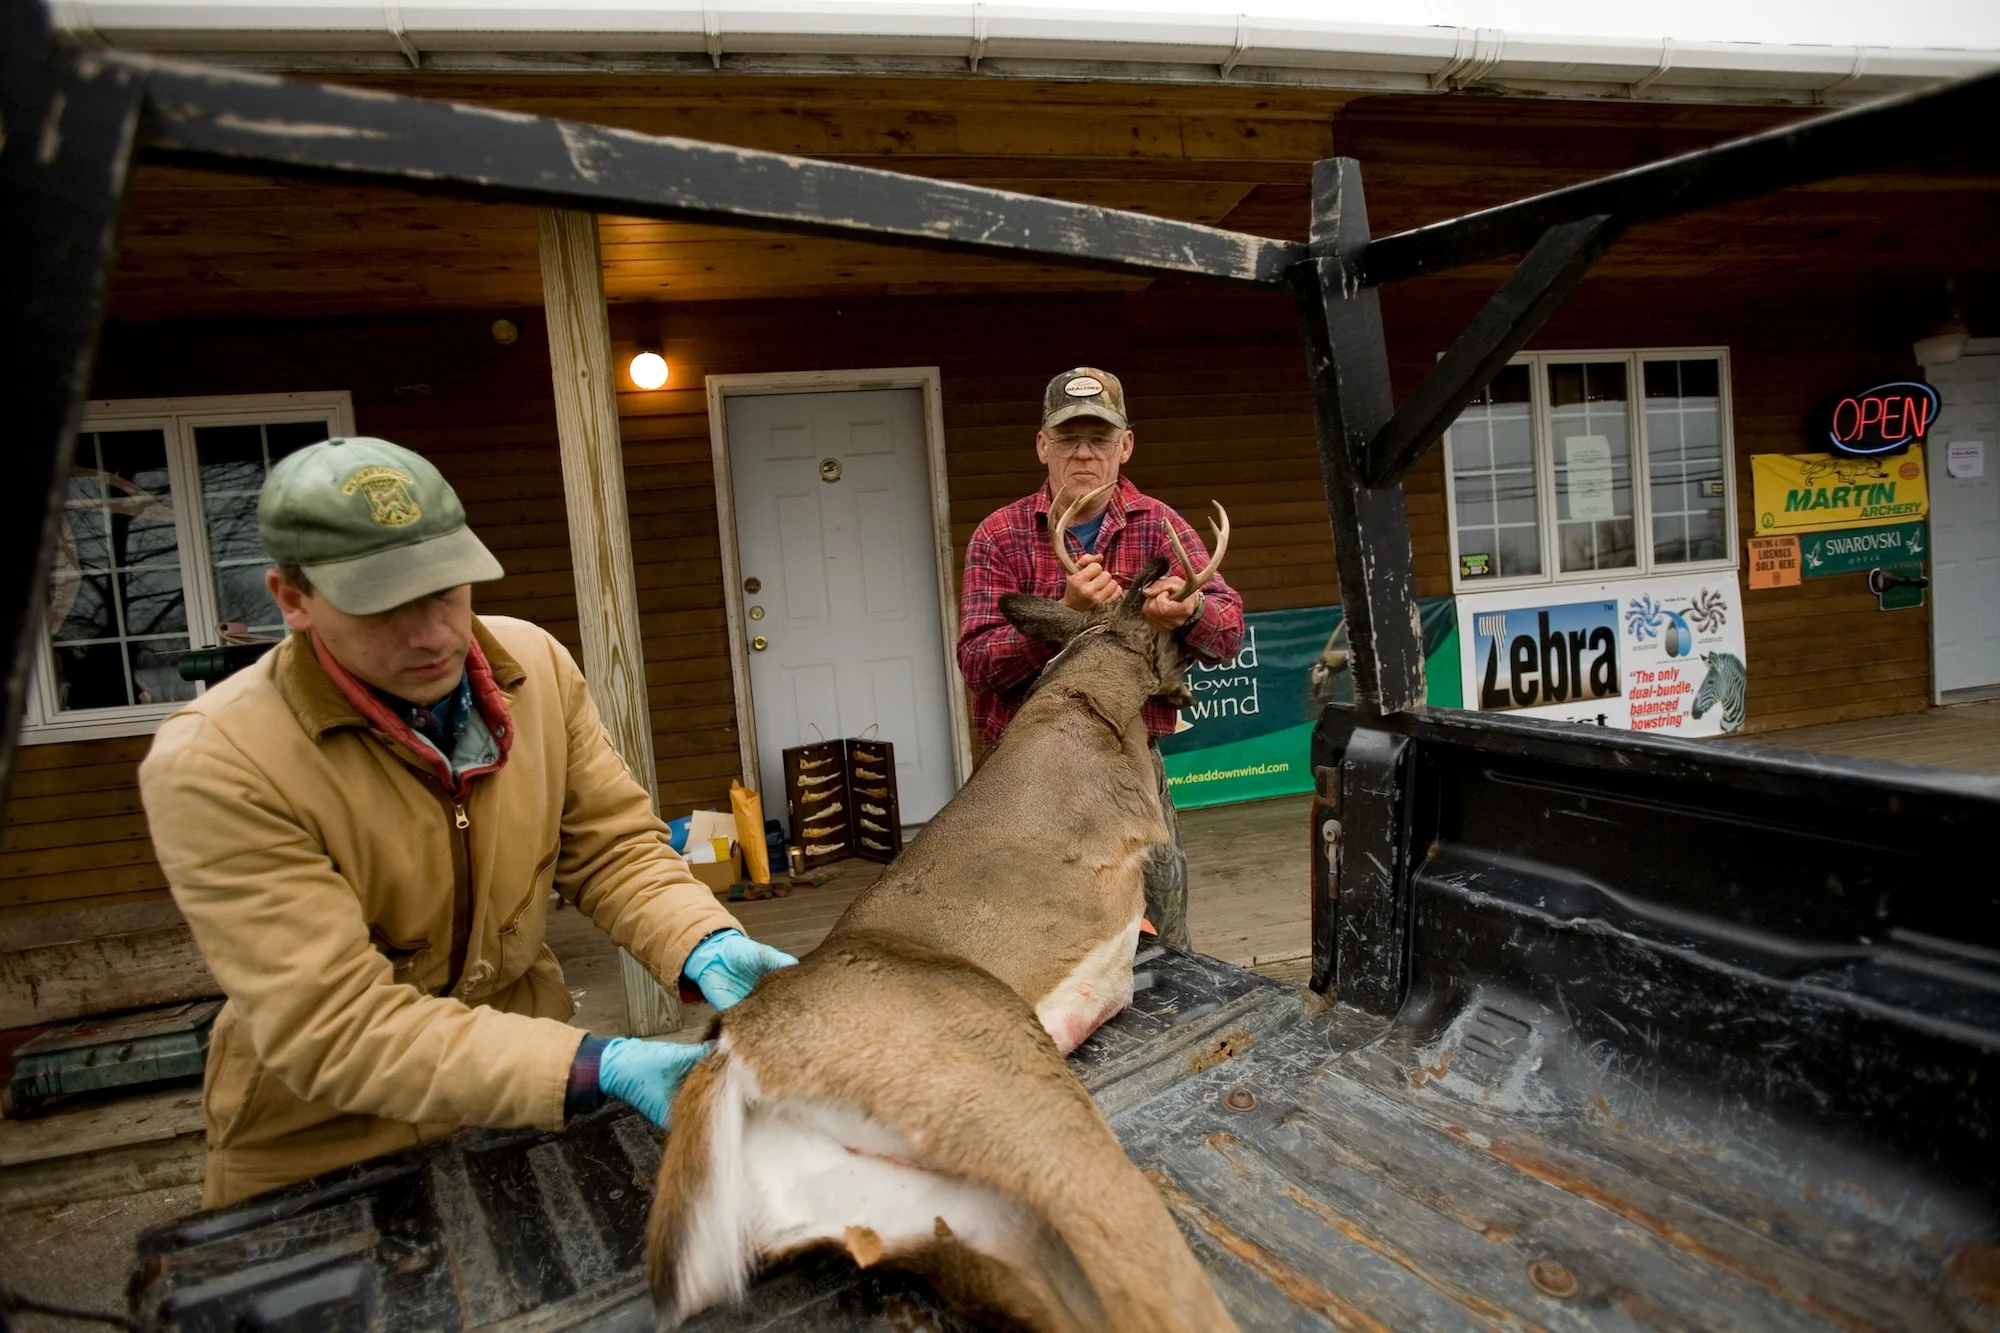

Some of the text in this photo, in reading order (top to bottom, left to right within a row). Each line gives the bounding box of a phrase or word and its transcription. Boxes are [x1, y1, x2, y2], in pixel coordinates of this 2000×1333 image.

[1832, 397, 1928, 441] OPEN
[1784, 481, 1897, 513] MARTIN
[1859, 502, 1922, 518] ARCHERY
[1825, 531, 1902, 556] SWAROVSKI
[1758, 548, 1792, 560] LICENSES
[1755, 558, 1796, 572] SOLD HERE
[1478, 611, 1619, 710] Zebra
[1658, 667, 1680, 681] only
[1189, 677, 1260, 721] wind
[1629, 681, 1694, 700] dual-bundle,
[1630, 697, 1680, 715] balanced
